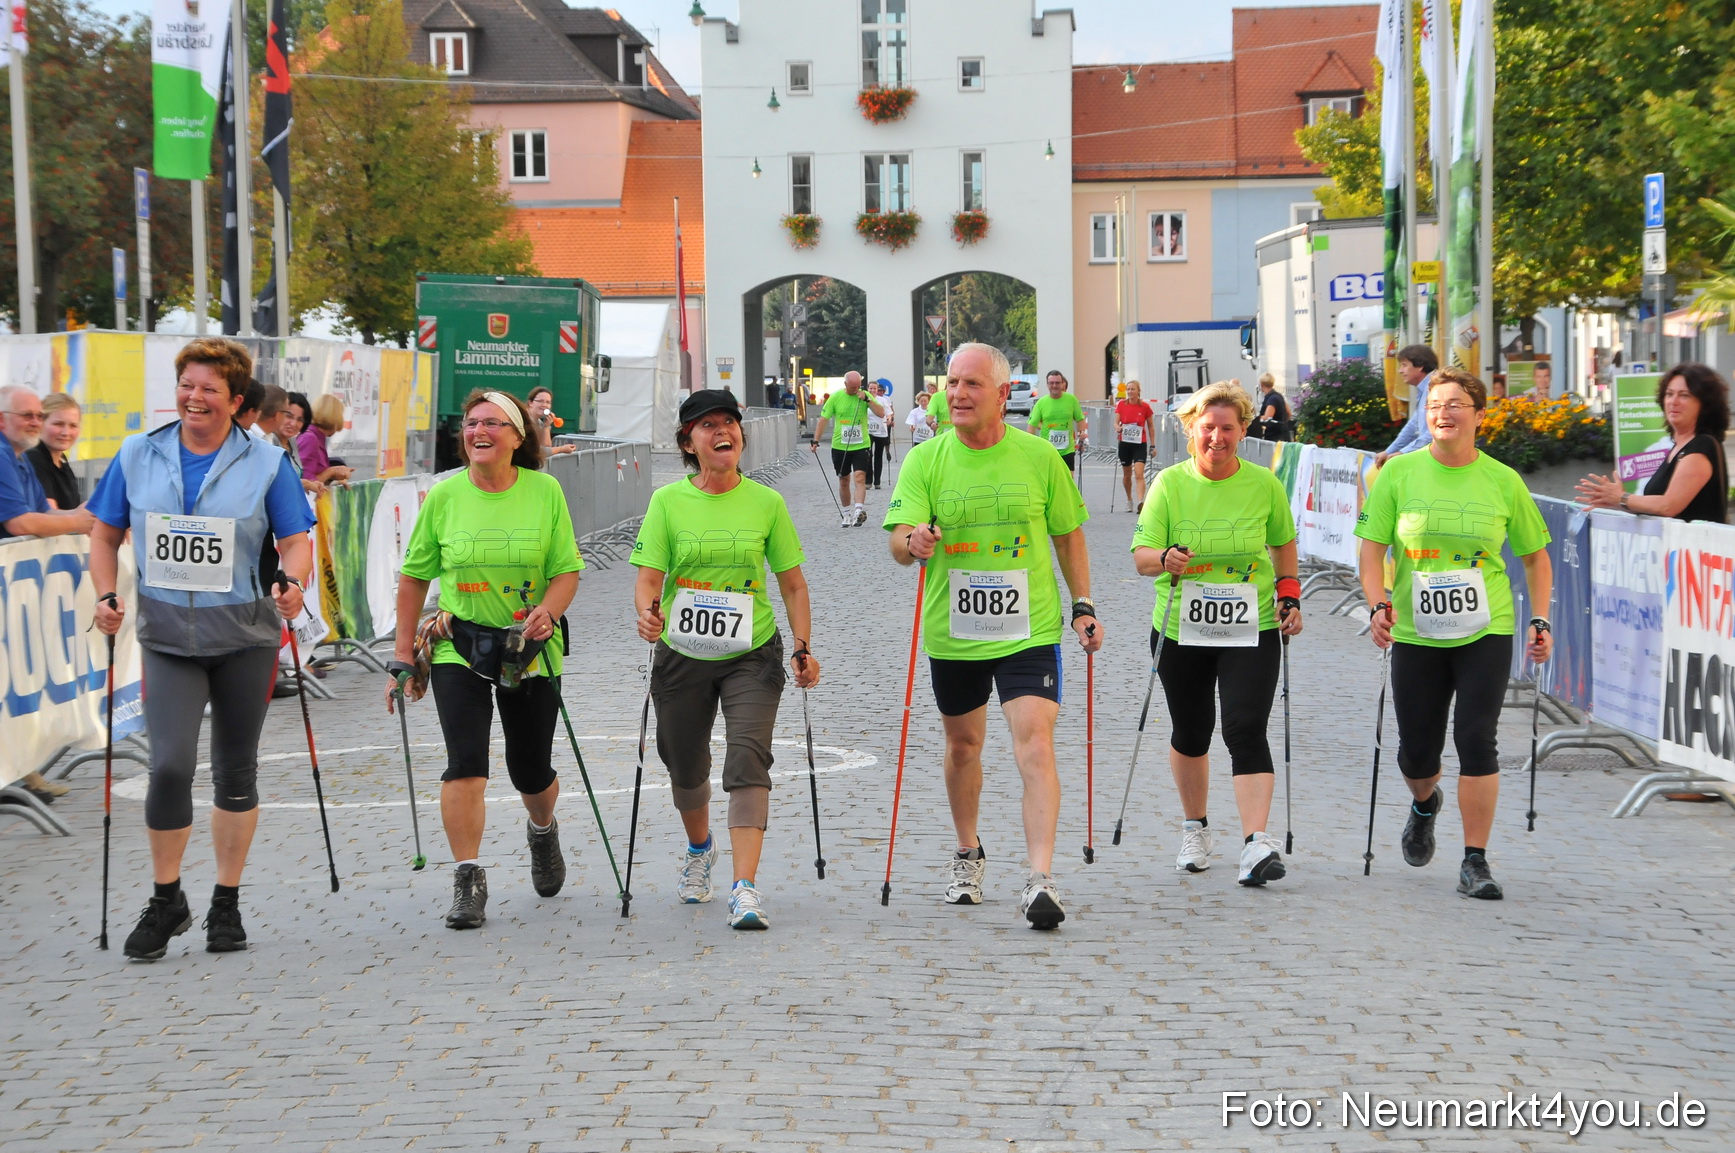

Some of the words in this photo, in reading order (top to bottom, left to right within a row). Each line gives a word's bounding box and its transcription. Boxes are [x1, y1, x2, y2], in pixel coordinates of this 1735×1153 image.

[467, 340, 529, 352] Neumarkter
[455, 350, 540, 366] Lammsbräu
[844, 430, 860, 438] 8093
[1124, 428, 1140, 436] 8059
[1636, 452, 1666, 462] WERNER
[170, 520, 206, 530] BOCK
[156, 534, 223, 564] 8065
[164, 566, 190, 580] Maria
[1184, 563, 1213, 574] ERZ
[970, 576, 1004, 584] BOCK
[1429, 575, 1461, 584] BOCK
[1203, 587, 1235, 596] BOCK
[694, 595, 729, 605] BOCK
[958, 588, 1020, 615] 8082
[1420, 587, 1479, 615] 8069
[1189, 599, 1249, 624] 8092
[678, 607, 743, 638] 8067
